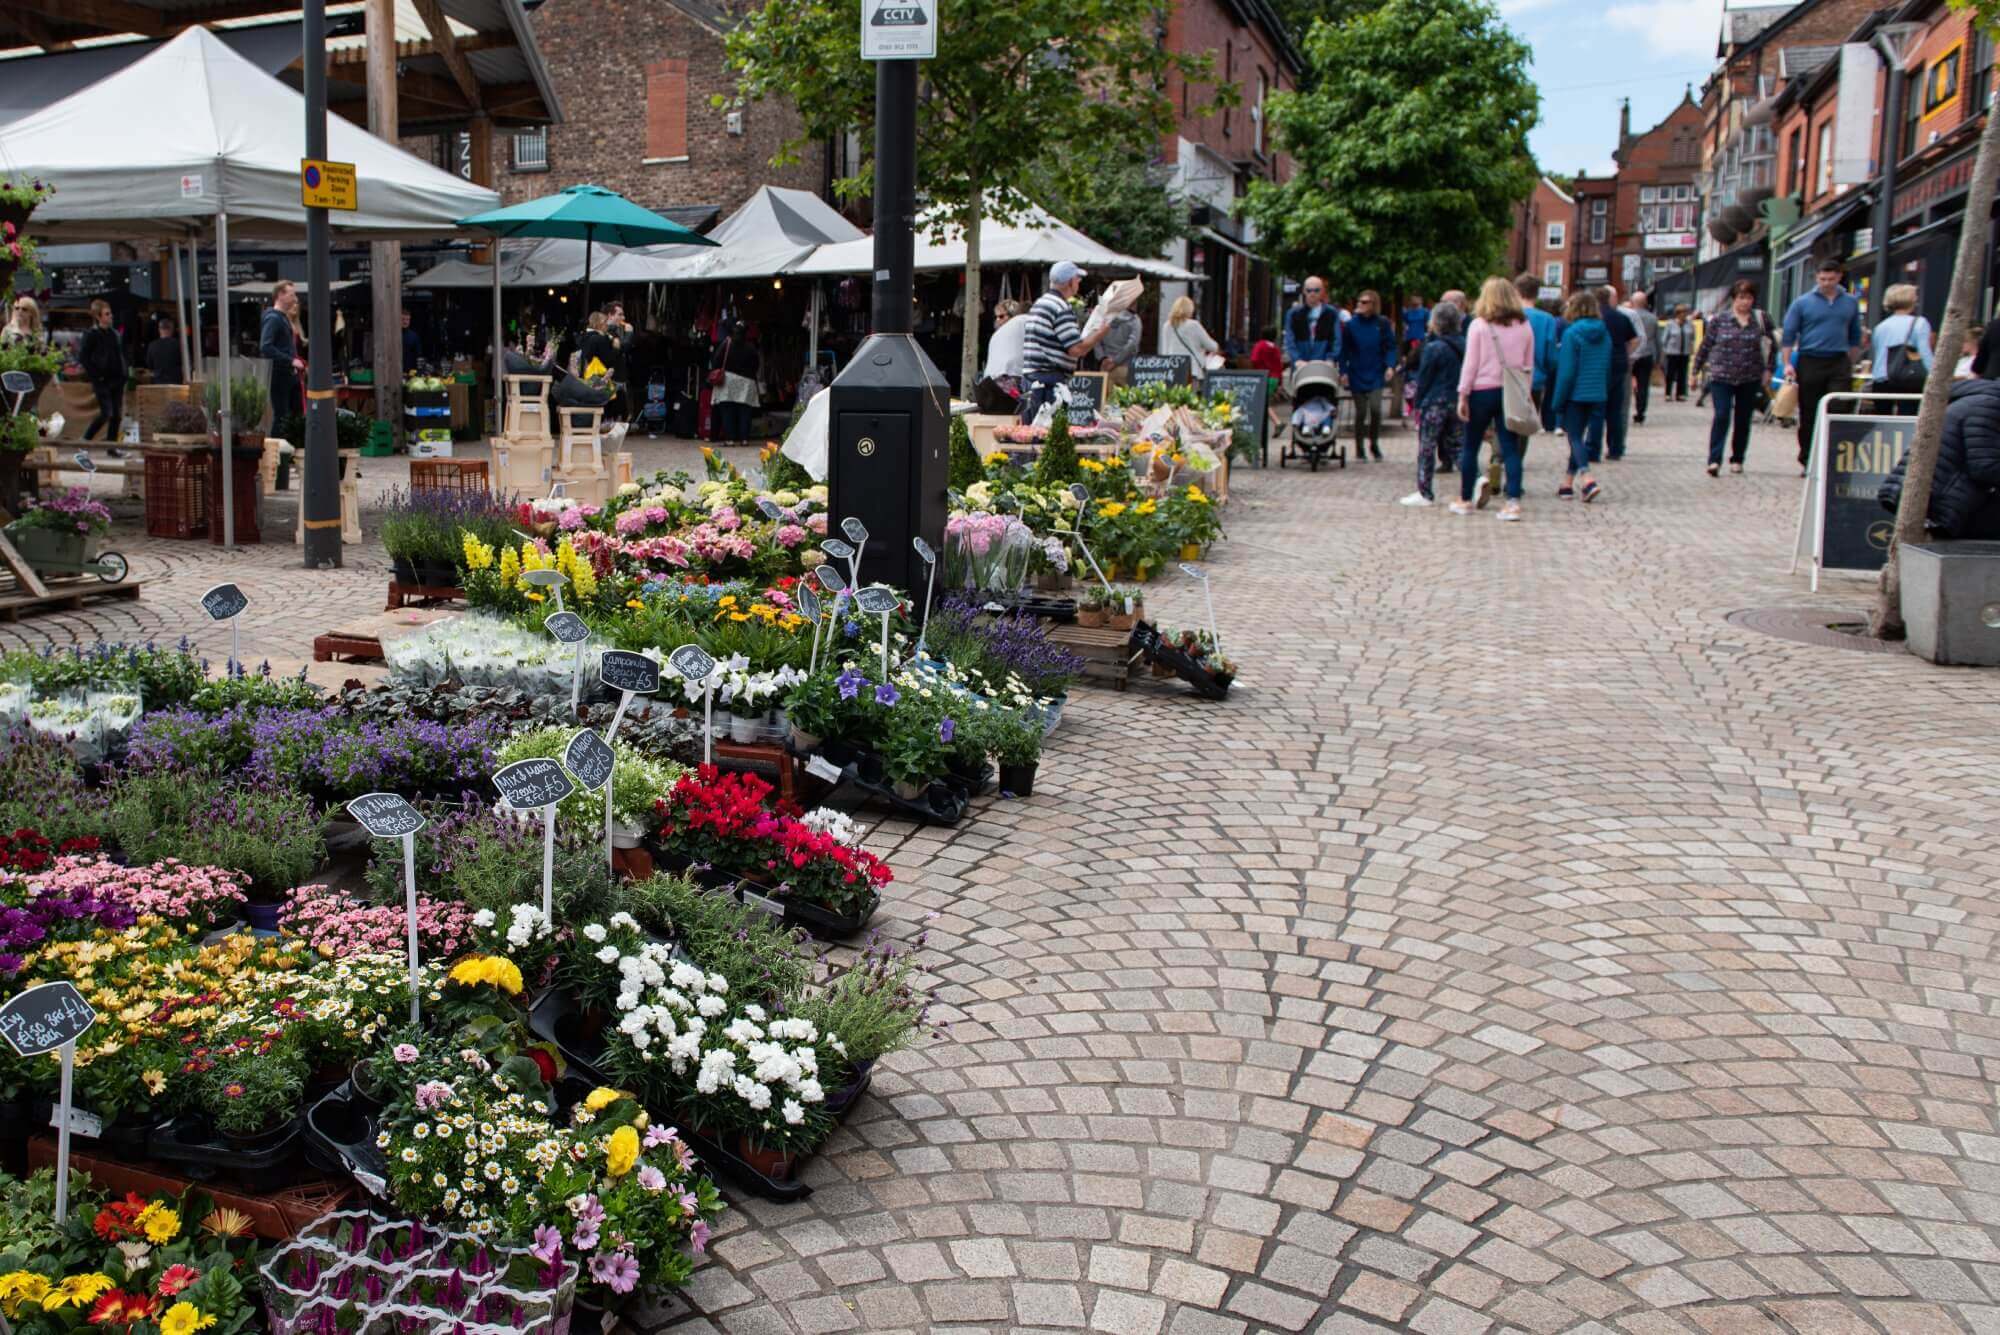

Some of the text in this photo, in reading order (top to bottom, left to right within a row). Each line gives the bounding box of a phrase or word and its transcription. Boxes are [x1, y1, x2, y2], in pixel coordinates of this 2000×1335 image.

[883, 9, 915, 20] CCTV
[322, 164, 352, 175] Restricted
[327, 174, 349, 185] Parking
[331, 184, 346, 192] Zone
[635, 670, 653, 690] £5
[495, 774, 521, 792] Mix
[525, 761, 557, 777] Match
[544, 774, 565, 799] £5
[396, 810, 417, 830] £5
[0, 1012, 26, 1032] Ivy
[61, 996, 90, 1031] £4
[36, 1028, 64, 1047] each
